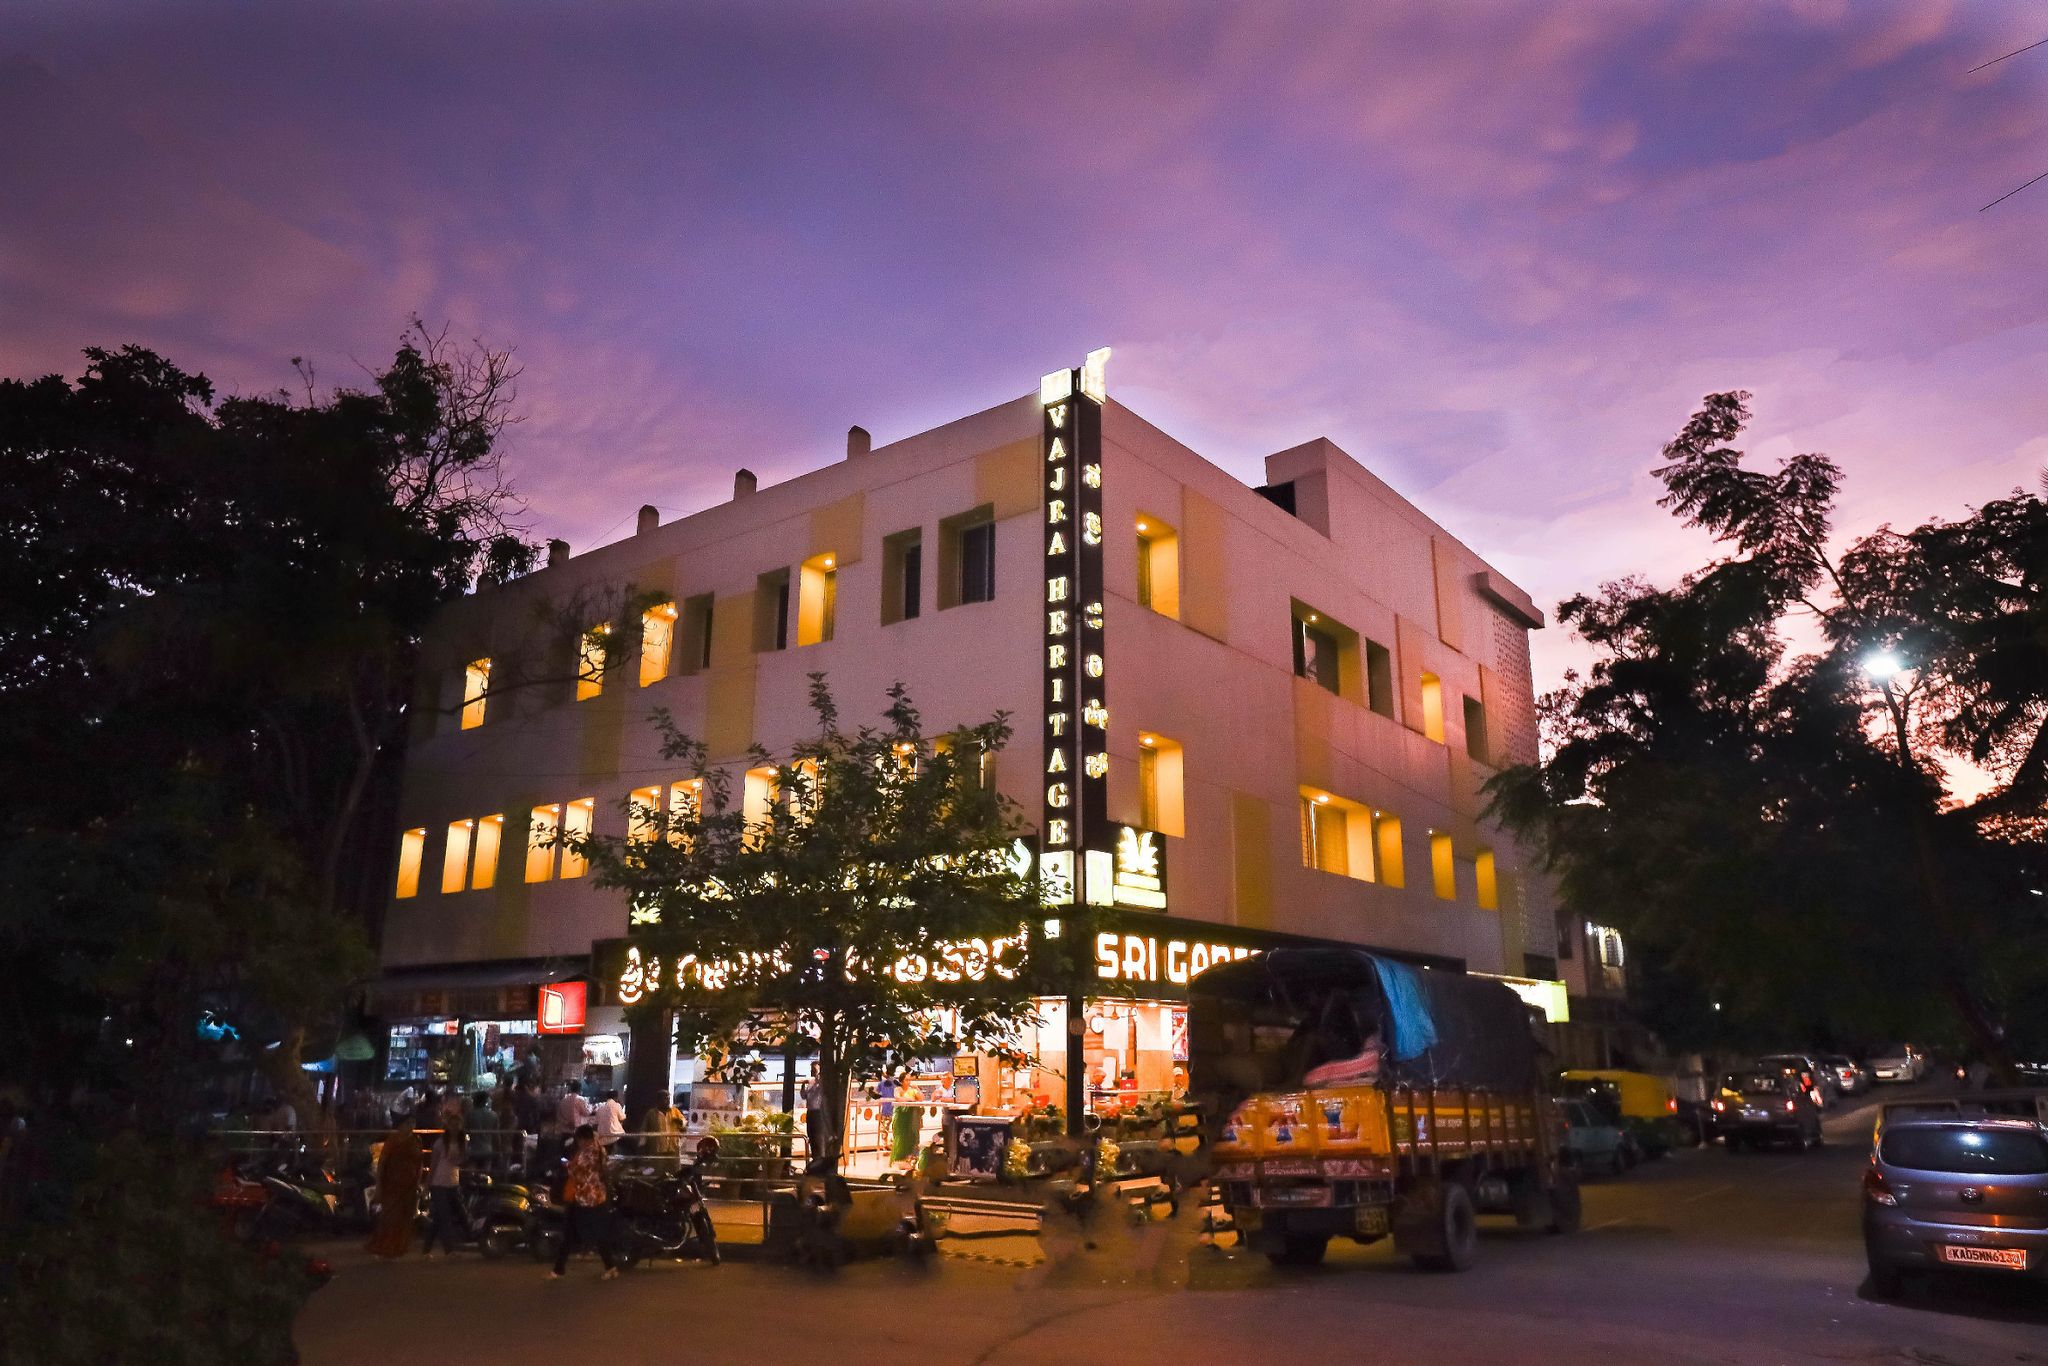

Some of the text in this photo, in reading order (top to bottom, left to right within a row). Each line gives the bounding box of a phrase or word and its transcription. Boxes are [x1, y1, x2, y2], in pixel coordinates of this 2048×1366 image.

[1047, 405, 1069, 845] VAJRA HERITAGE
[1096, 932, 1157, 981] SRI
